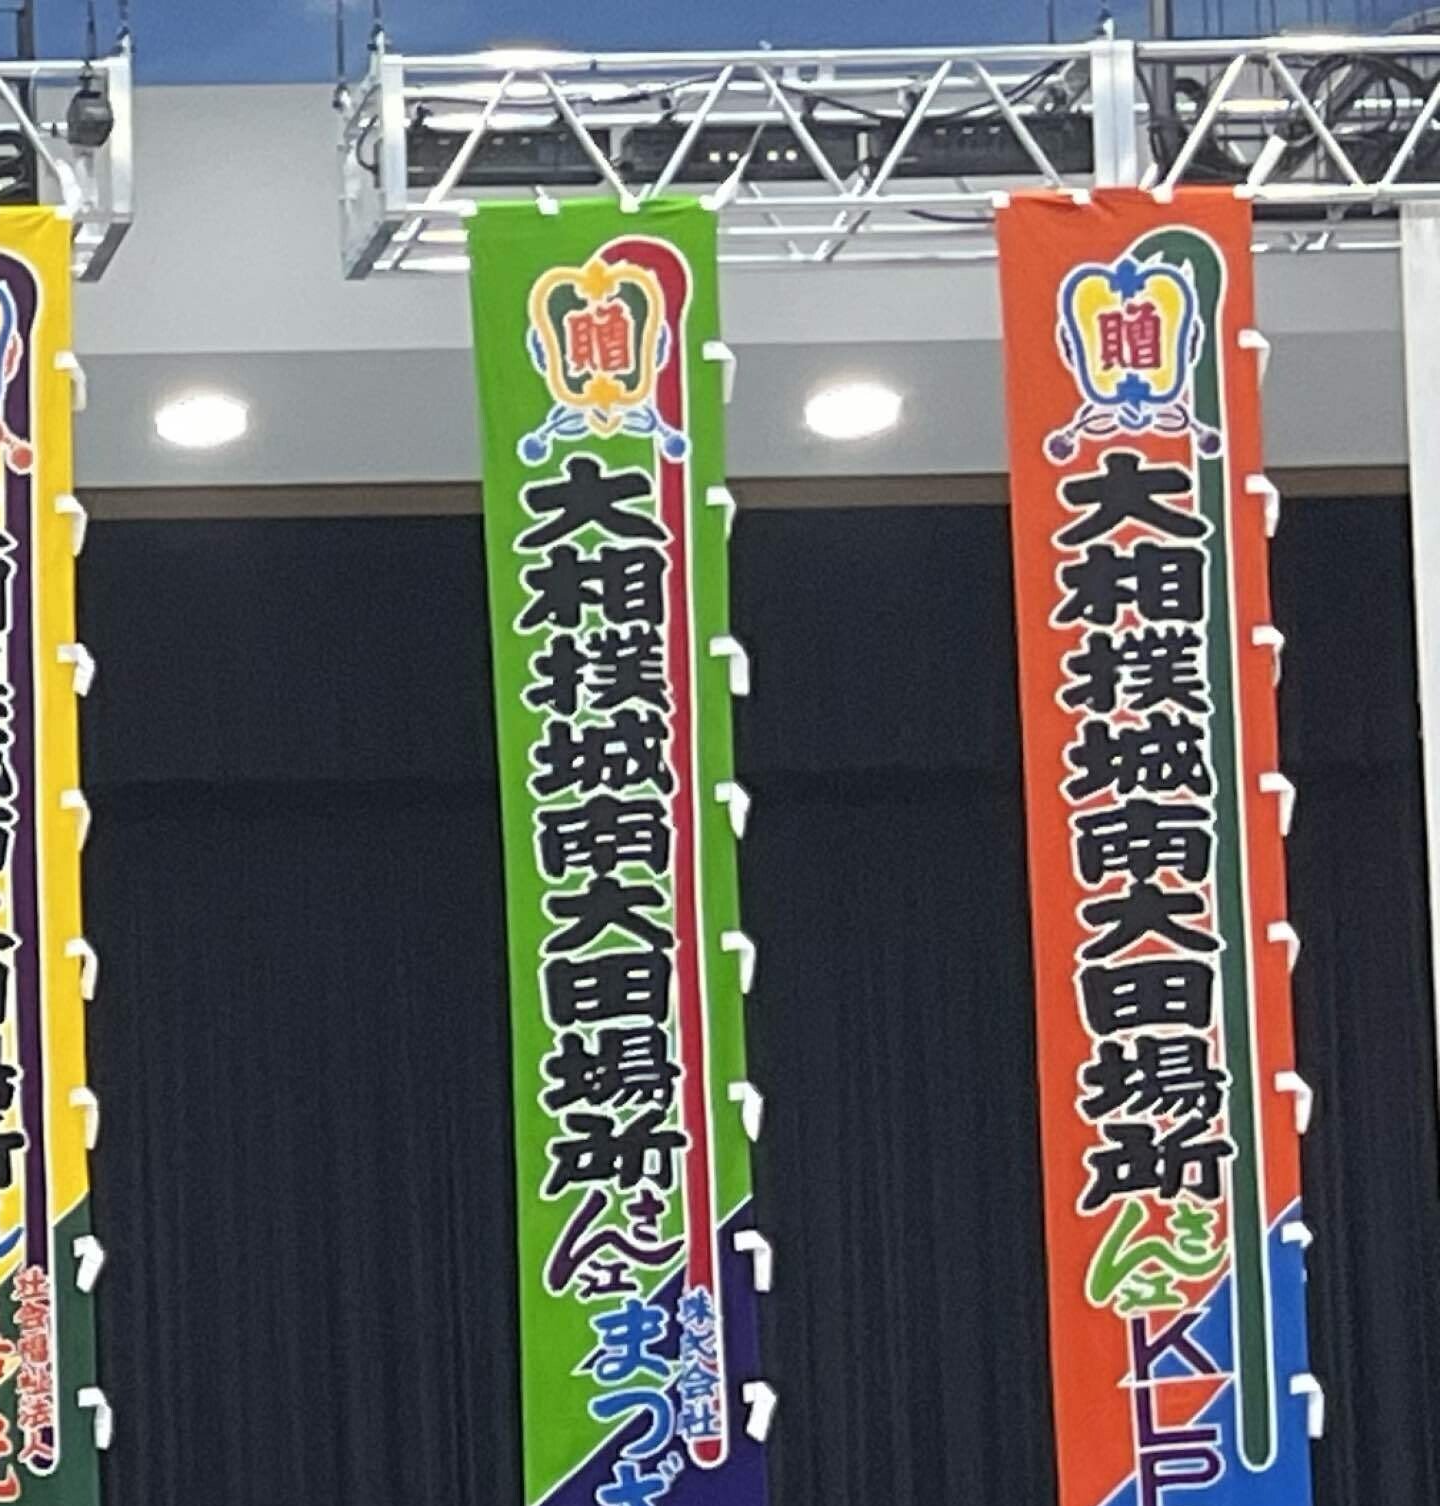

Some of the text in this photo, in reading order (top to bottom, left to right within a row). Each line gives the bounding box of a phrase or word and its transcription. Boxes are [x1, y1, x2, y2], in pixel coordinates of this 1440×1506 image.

[564, 305, 631, 373] 贈
[1098, 302, 1162, 372] 贈
[515, 457, 689, 1197] 大相撲城南大田場所
[1050, 455, 1235, 1210] 大相撲城南大田場所
[13, 1265, 53, 1460] 社会福祉法人
[680, 1288, 722, 1438] 株式会社
